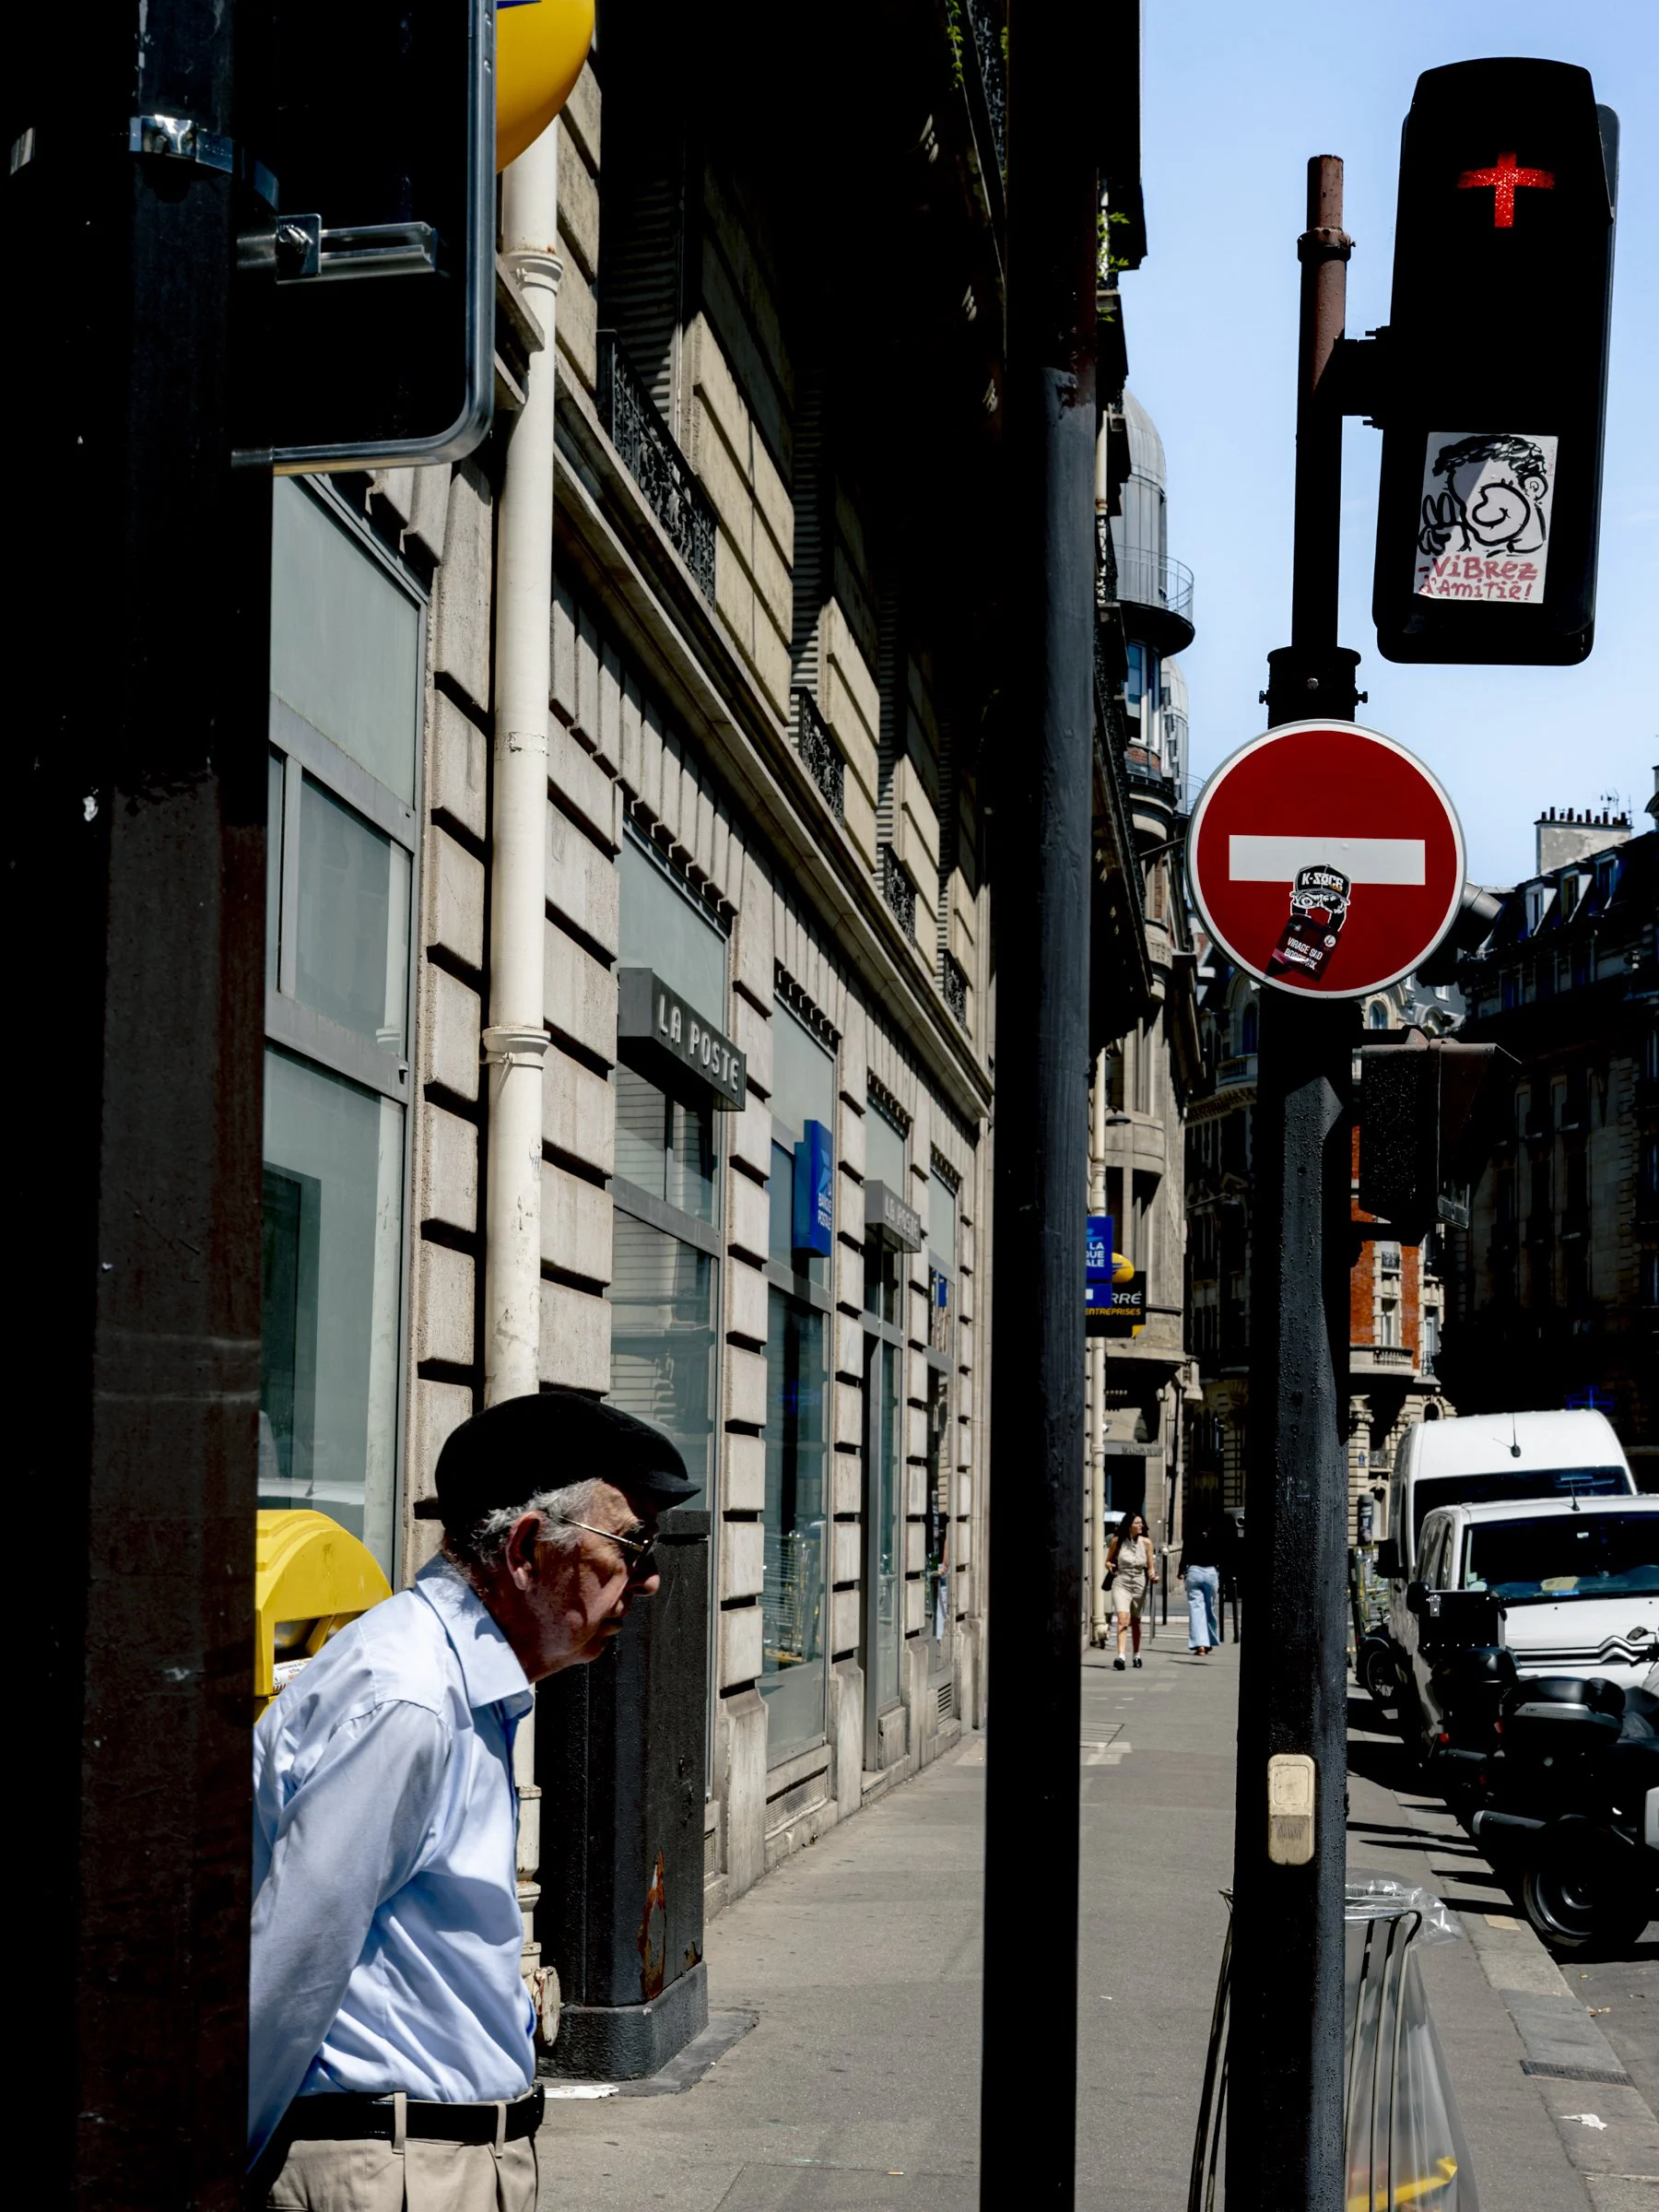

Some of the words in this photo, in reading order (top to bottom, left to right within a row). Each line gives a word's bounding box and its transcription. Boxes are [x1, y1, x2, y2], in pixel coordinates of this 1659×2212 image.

[1287, 936, 1311, 955] VIRAGE
[659, 994, 682, 1043] LA
[689, 1020, 739, 1091] POSTE
[897, 1205, 918, 1241] POSTE
[1089, 1241, 1104, 1250] LA
